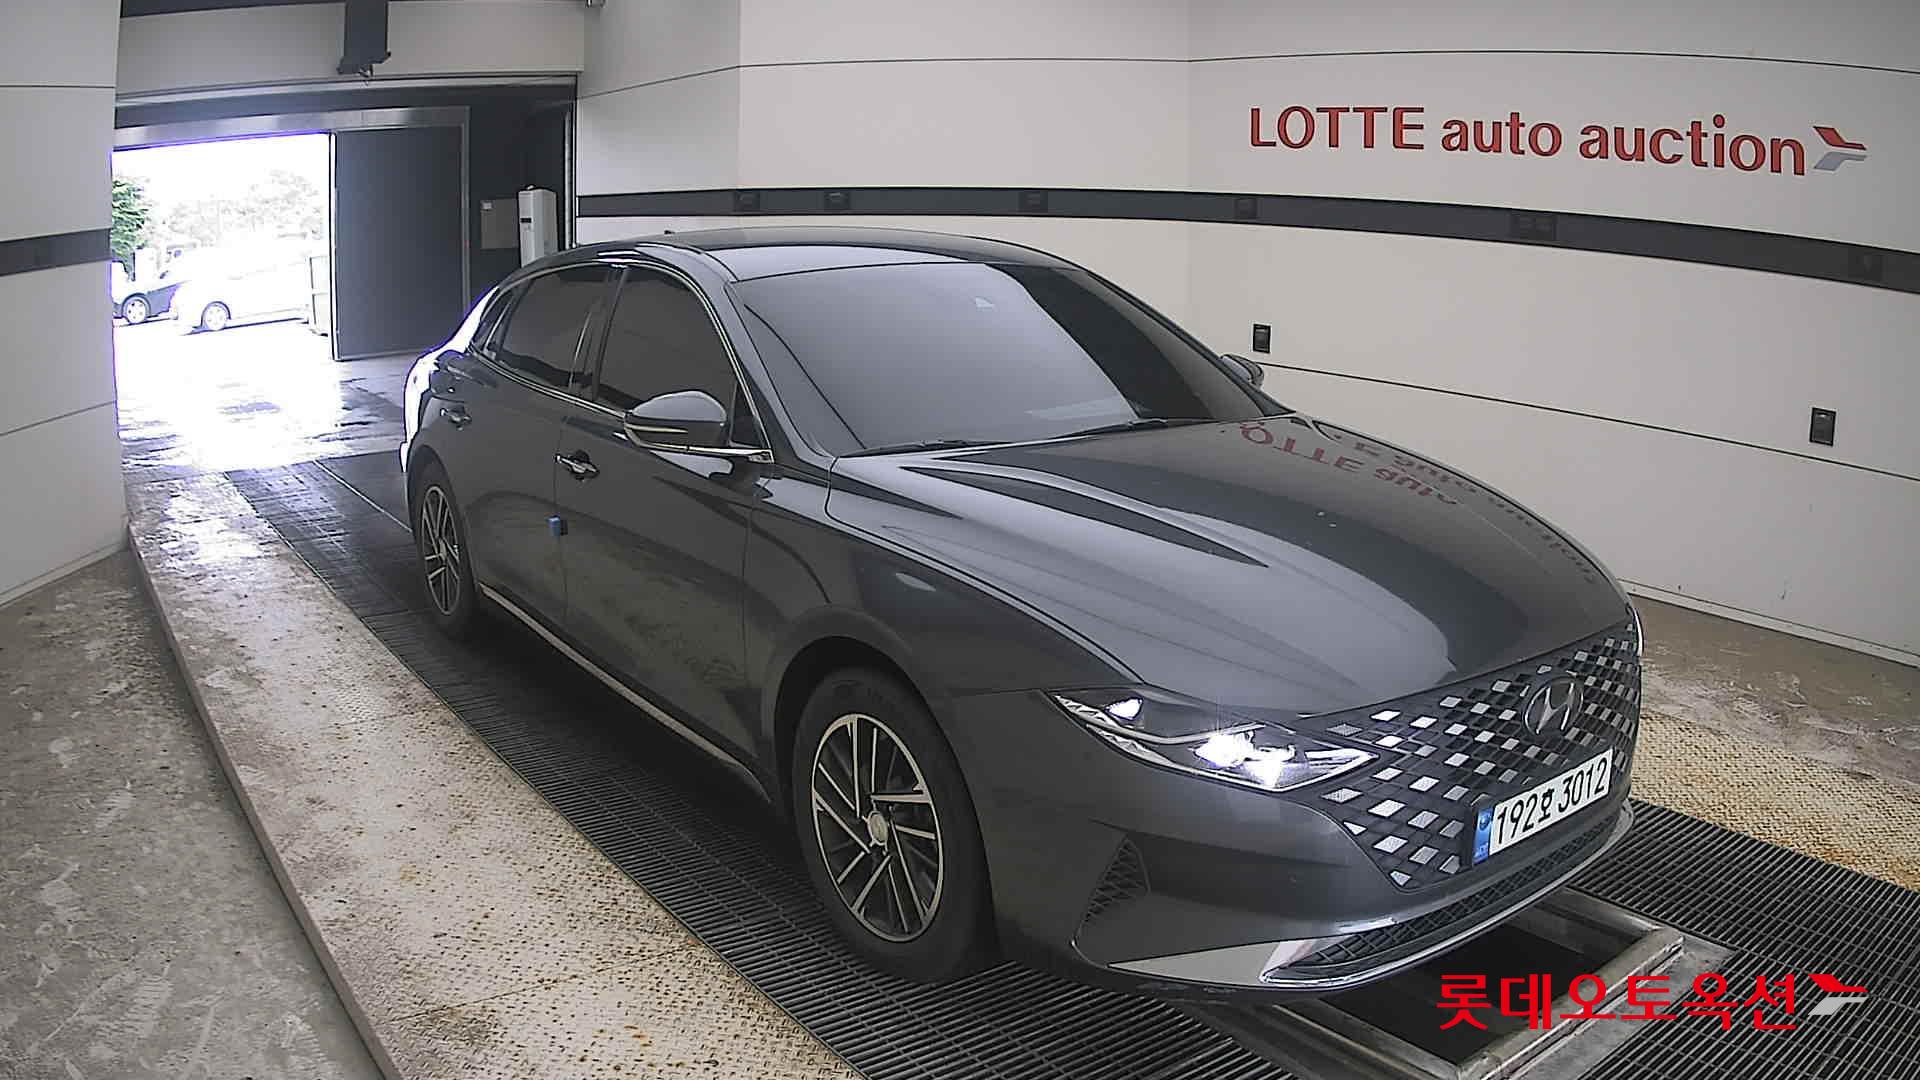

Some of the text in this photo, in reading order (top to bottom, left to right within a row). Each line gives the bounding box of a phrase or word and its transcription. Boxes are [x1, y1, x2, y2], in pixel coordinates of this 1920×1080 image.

[1250, 105, 1806, 177] LOTTE auto auction
[1557, 756, 1609, 814] 3012
